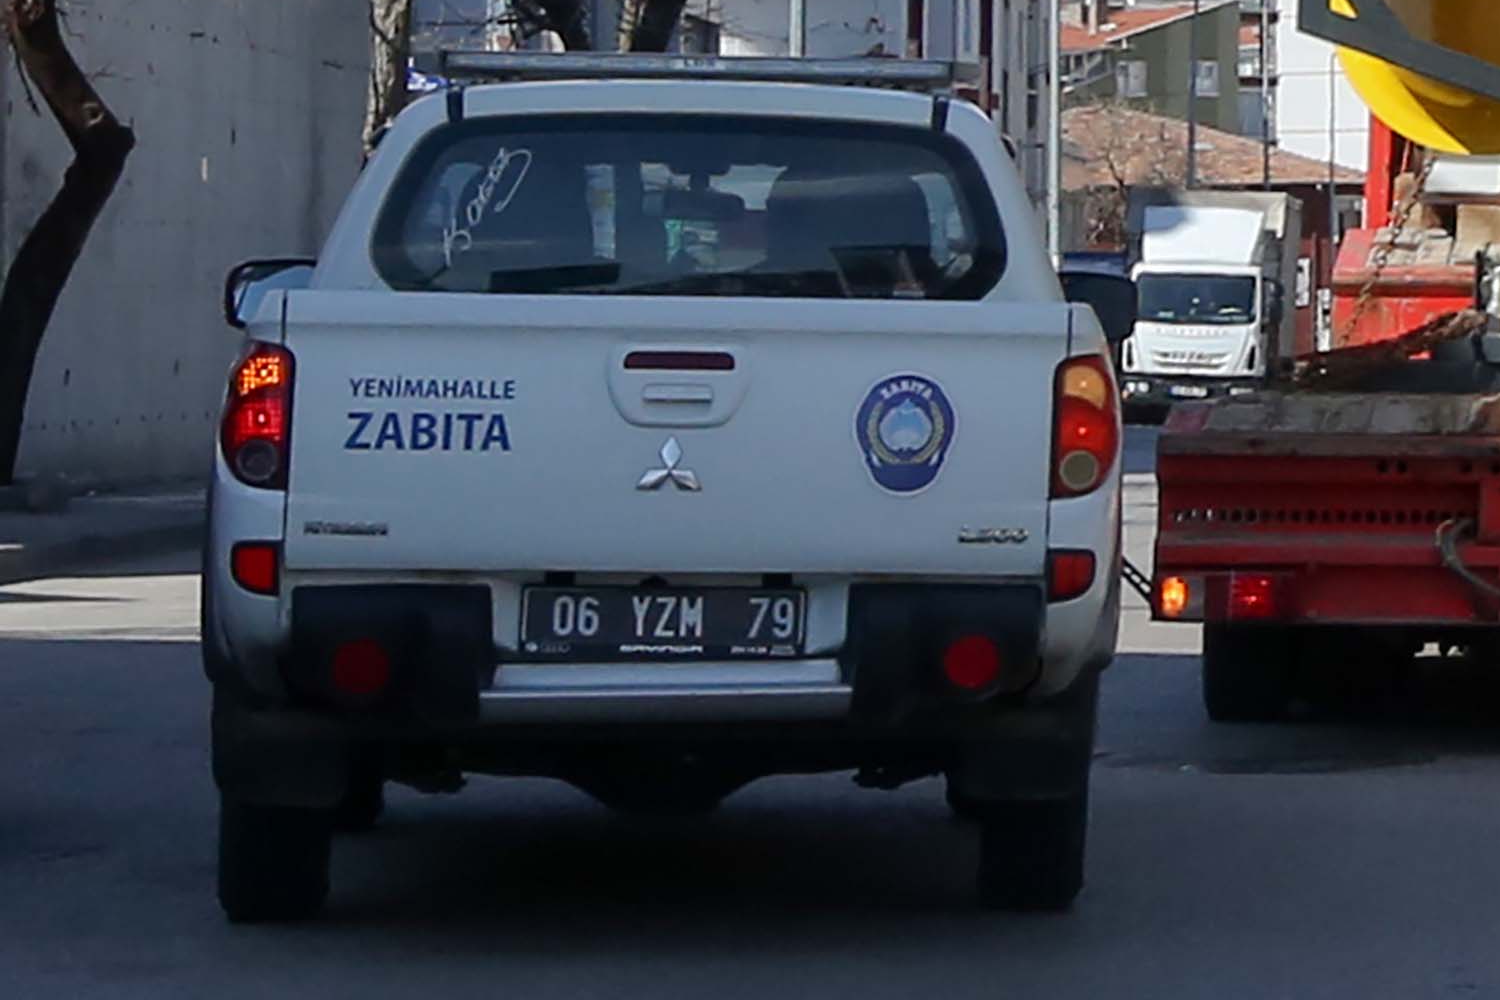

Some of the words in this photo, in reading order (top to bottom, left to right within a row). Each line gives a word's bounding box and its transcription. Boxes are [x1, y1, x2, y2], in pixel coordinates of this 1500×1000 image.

[349, 374, 516, 399] YENİMAHALLE
[344, 412, 511, 451] ZABITA
[553, 596, 599, 636] 06
[632, 596, 704, 637] YZM
[748, 597, 794, 639] 79
